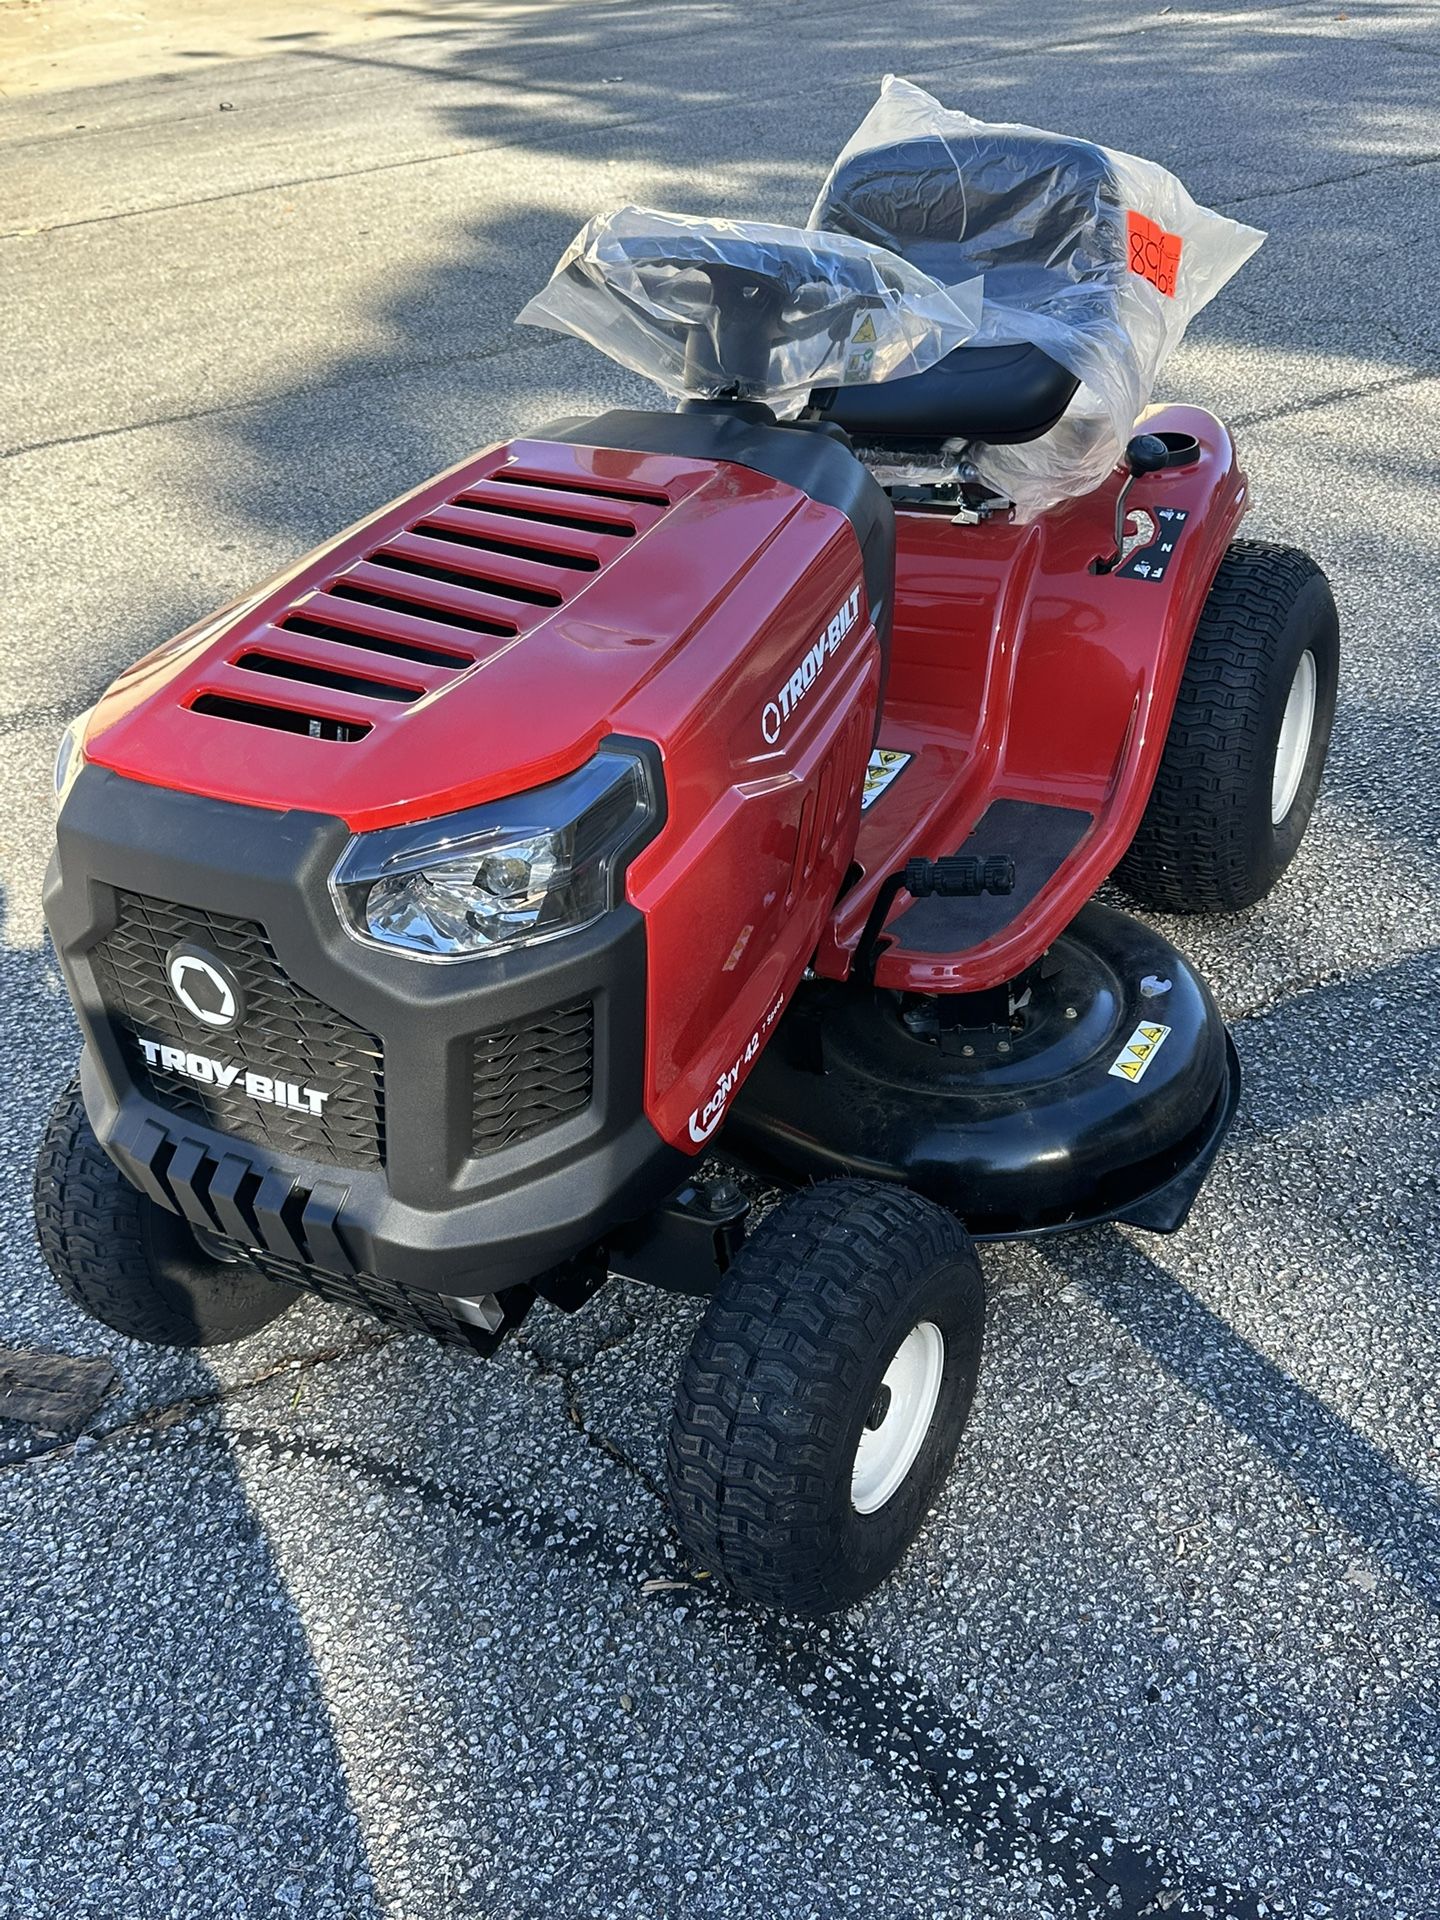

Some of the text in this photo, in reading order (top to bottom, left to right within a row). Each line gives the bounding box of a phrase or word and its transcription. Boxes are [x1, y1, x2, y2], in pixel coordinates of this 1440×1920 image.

[1175, 512, 1186, 521] R
[1160, 542, 1173, 553] N
[1151, 567, 1164, 578] F
[777, 585, 861, 723] TROY-BILT
[744, 1032, 760, 1064] 42
[138, 1037, 330, 1117] TROY-BILT
